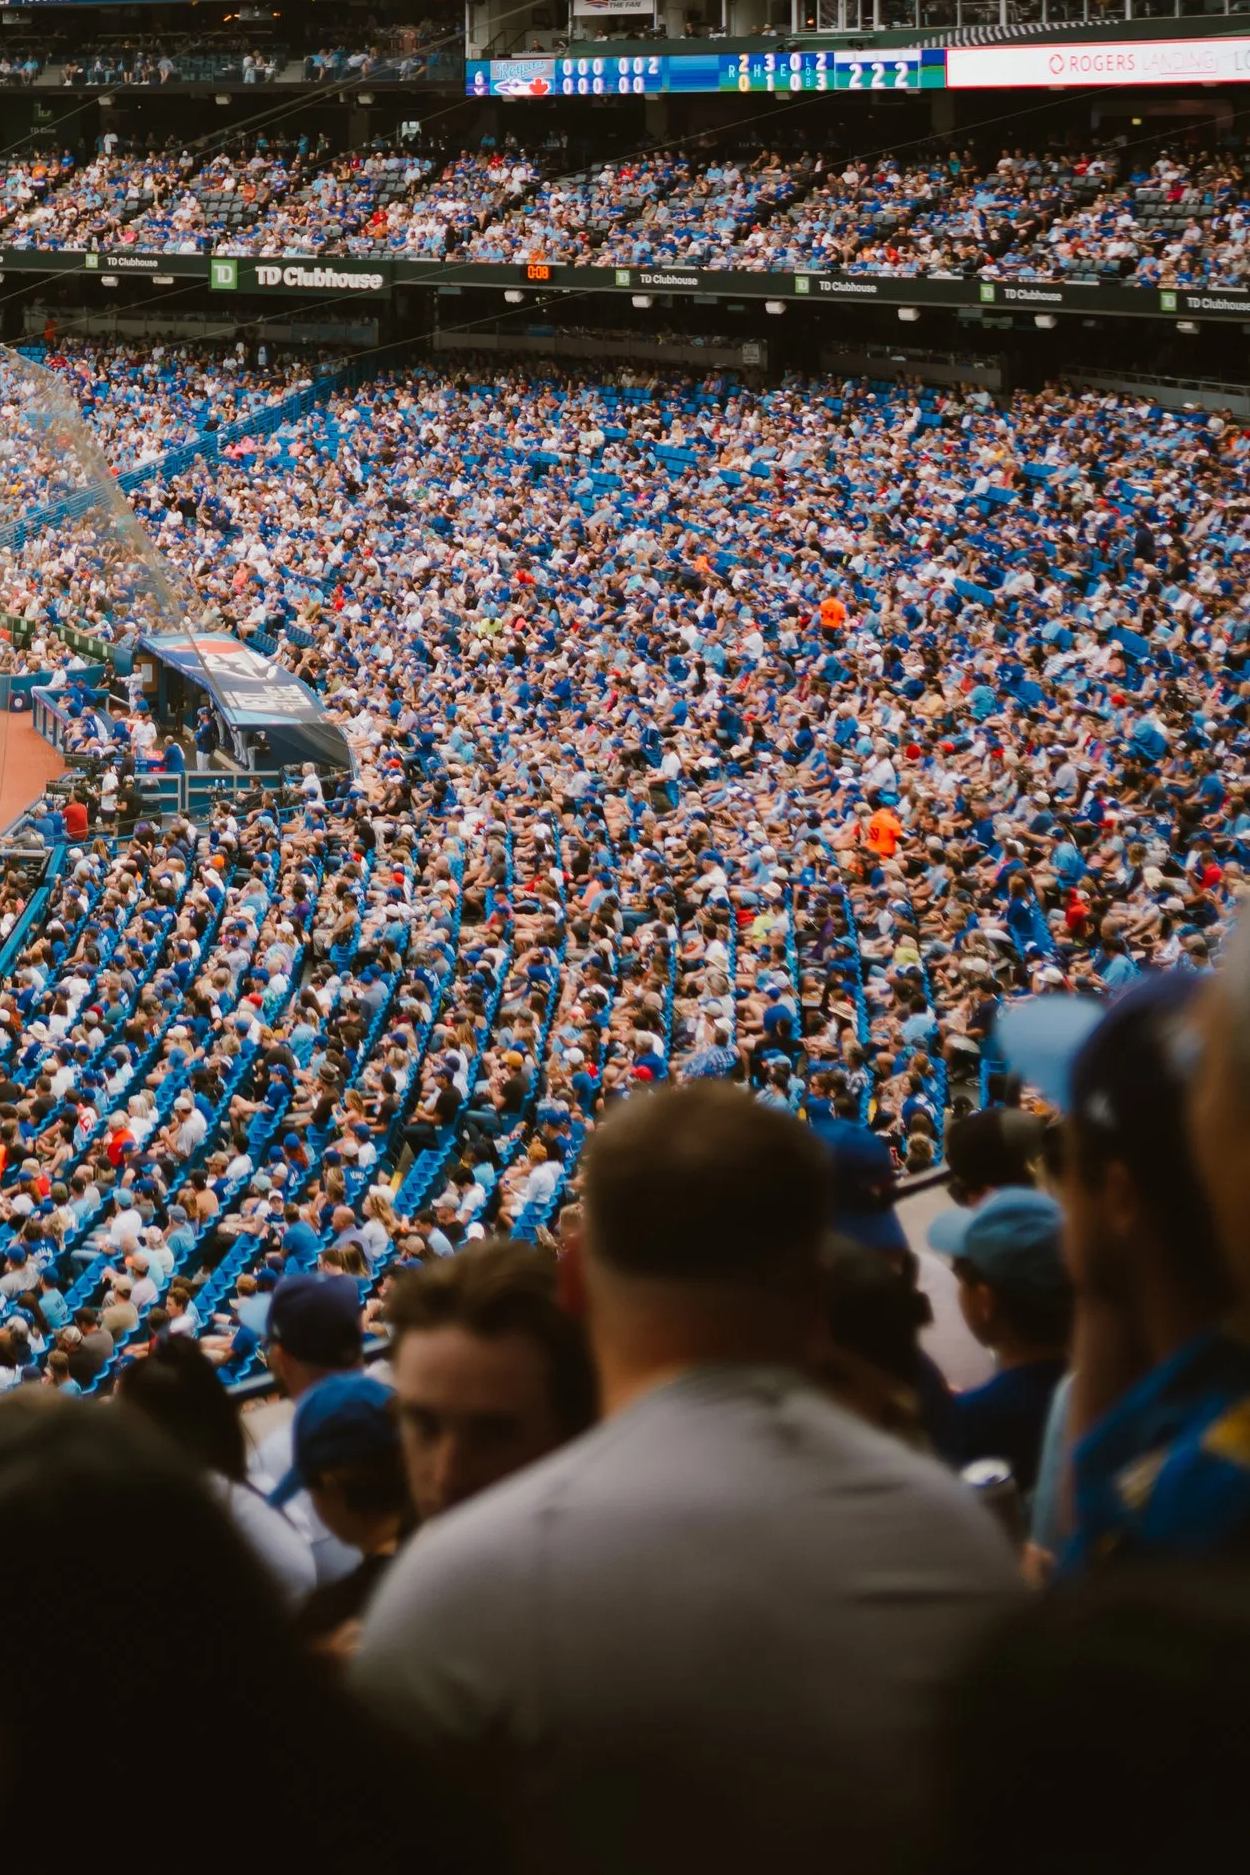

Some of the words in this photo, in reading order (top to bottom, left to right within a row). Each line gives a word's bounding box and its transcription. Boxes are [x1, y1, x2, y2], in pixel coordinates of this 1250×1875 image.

[738, 53, 750, 72] 2
[764, 53, 776, 72] 3
[789, 52, 802, 71] 0
[815, 52, 827, 71] 2
[1069, 53, 1136, 73] ROGERS
[1141, 50, 1215, 71] LANDING
[728, 65, 736, 78] R
[753, 64, 761, 77] H
[780, 63, 787, 77] E
[849, 62, 863, 88] 2
[871, 62, 886, 88] 2
[894, 61, 909, 88] 2
[474, 71, 484, 85] 6
[738, 73, 750, 92] 0
[765, 73, 774, 92] 1
[790, 73, 802, 92] 0
[815, 72, 827, 91] 3
[107, 257, 120, 267] TD
[120, 257, 158, 268] Clubhouse
[256, 266, 282, 285] TD
[283, 266, 383, 289] Clubhouse
[527, 265, 549, 279] 0:08
[640, 273, 652, 284] TD
[653, 274, 698, 286] Clubhouse
[819, 280, 831, 292] TD
[832, 281, 877, 294] Clubhouse
[1004, 288, 1017, 300] TD
[1017, 289, 1062, 302] Clubhouse
[1187, 296, 1200, 309] TD
[1201, 297, 1250, 310] Clubhouse
